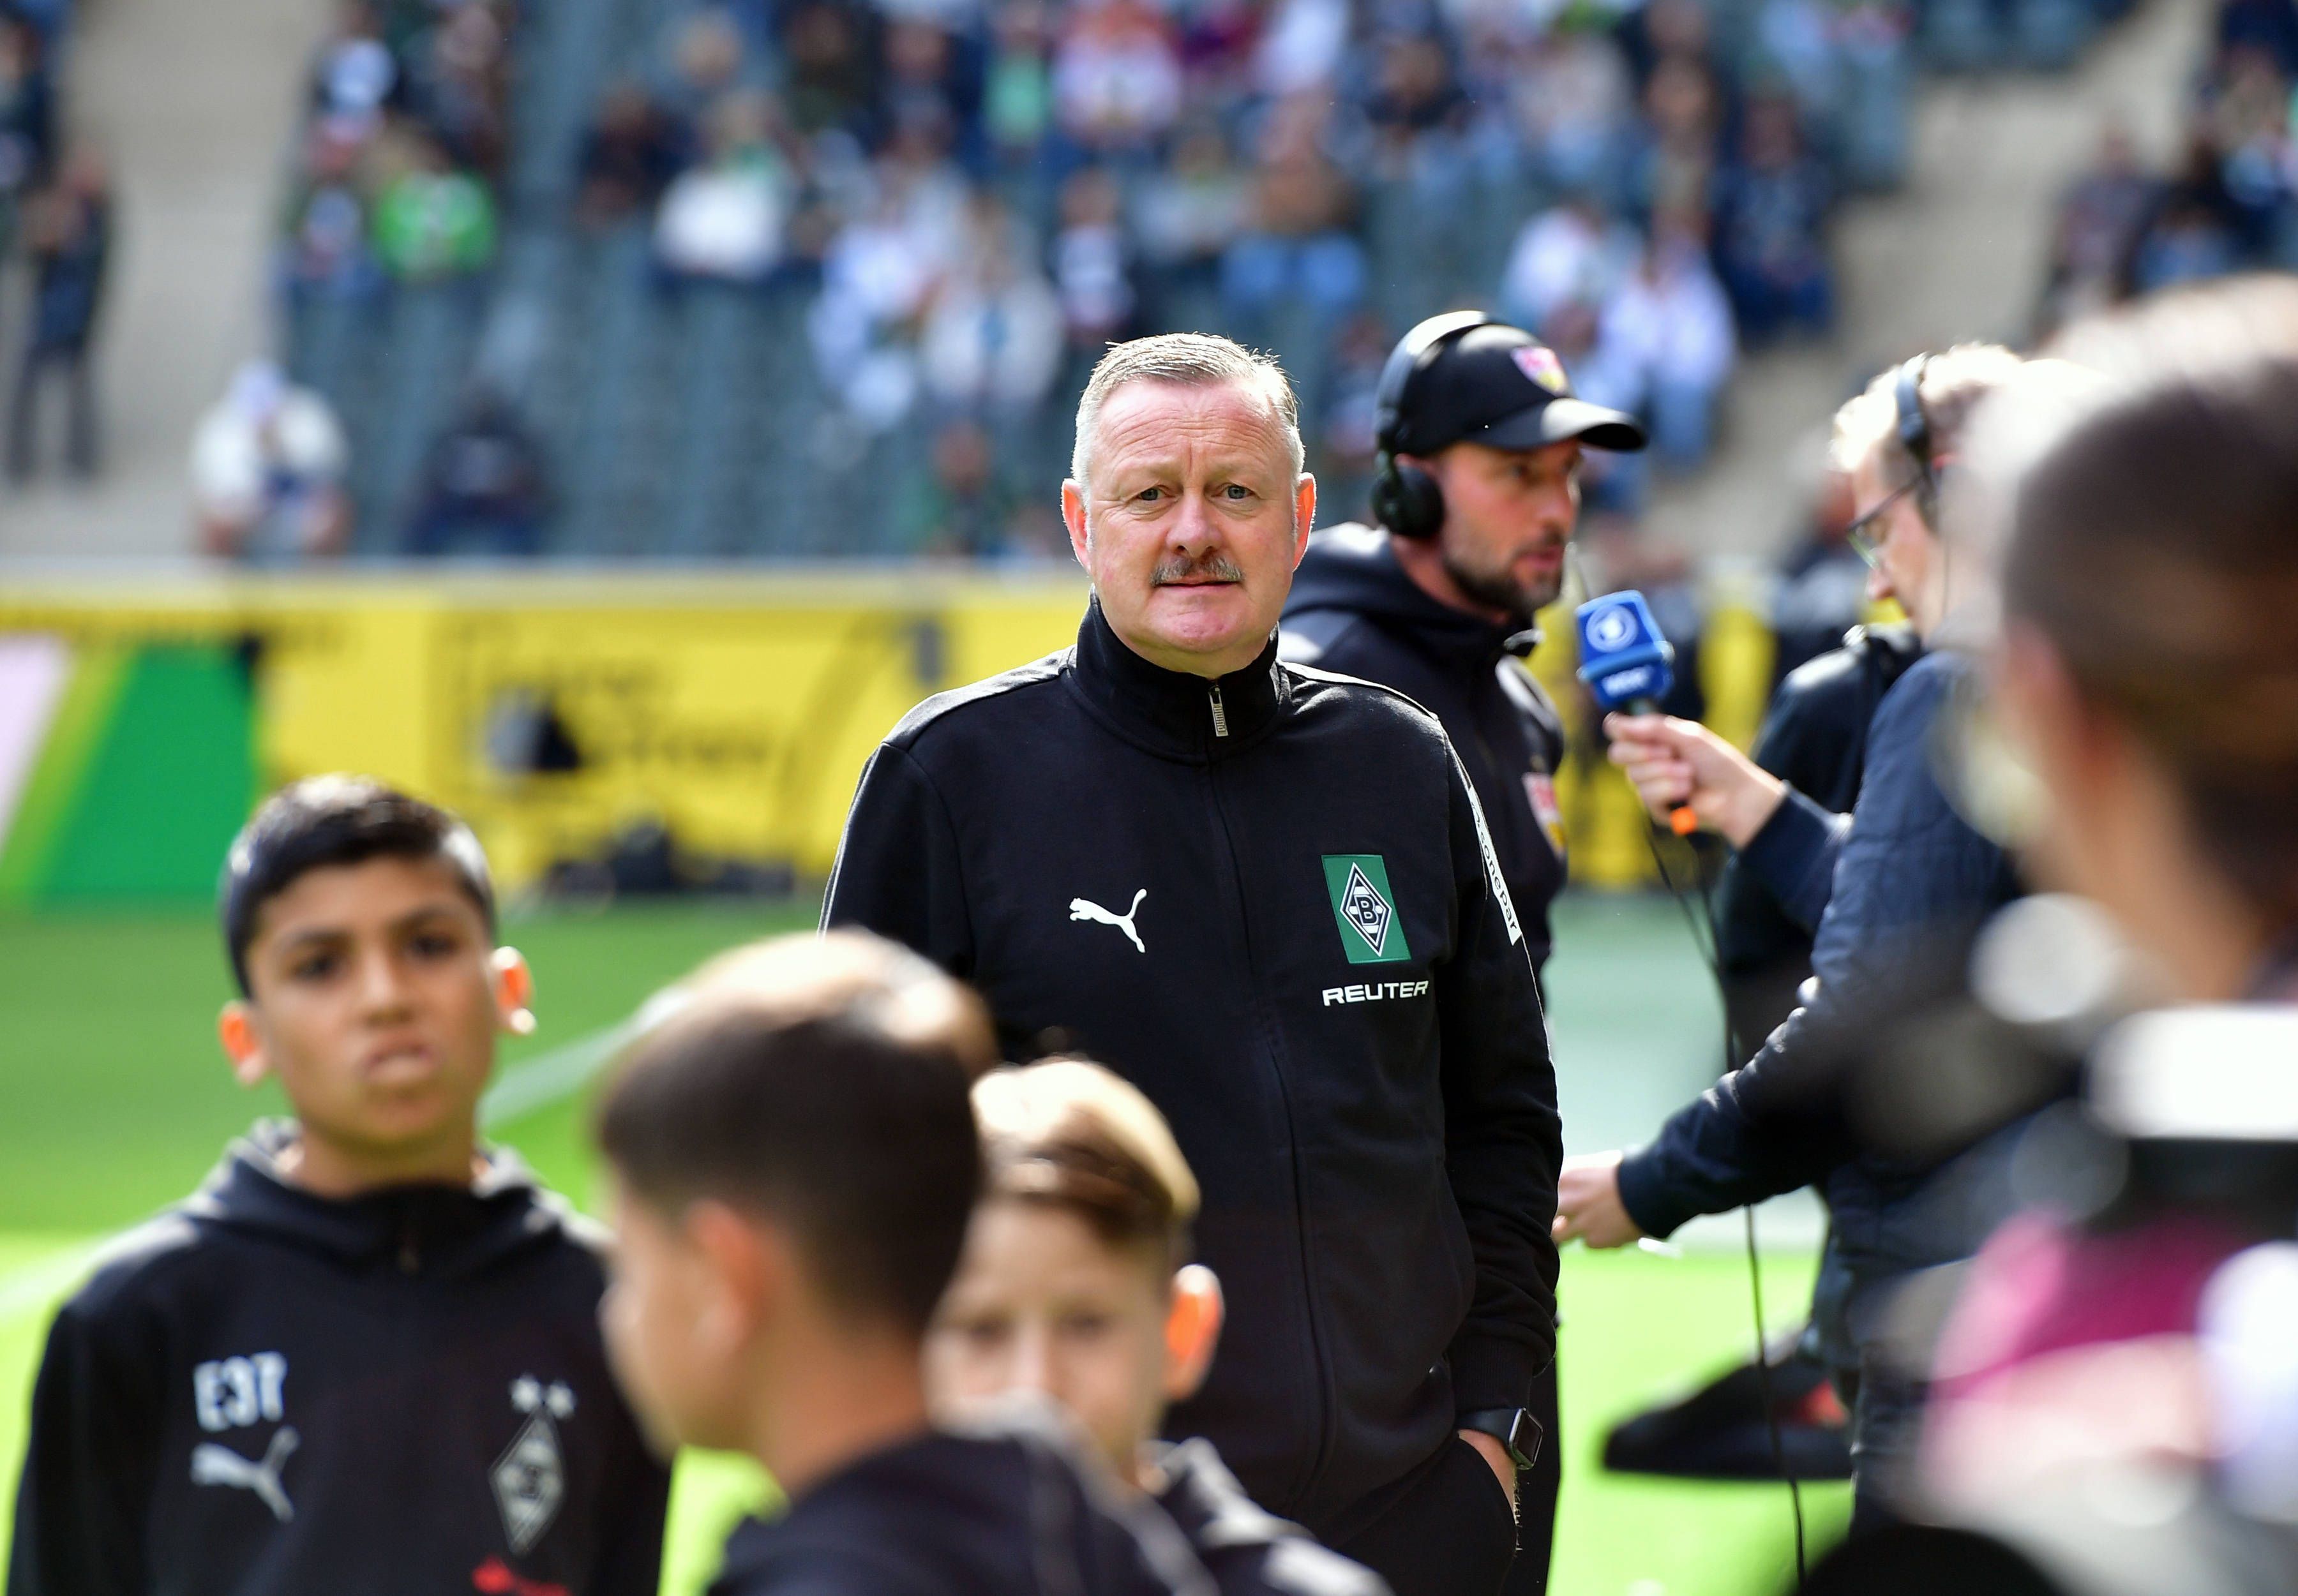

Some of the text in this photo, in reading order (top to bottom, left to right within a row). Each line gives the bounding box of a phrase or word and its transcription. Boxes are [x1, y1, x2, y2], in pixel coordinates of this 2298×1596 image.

[1480, 832, 1517, 929] sonepar
[1353, 894, 1379, 925] B
[1322, 980, 1429, 1006] REUTER
